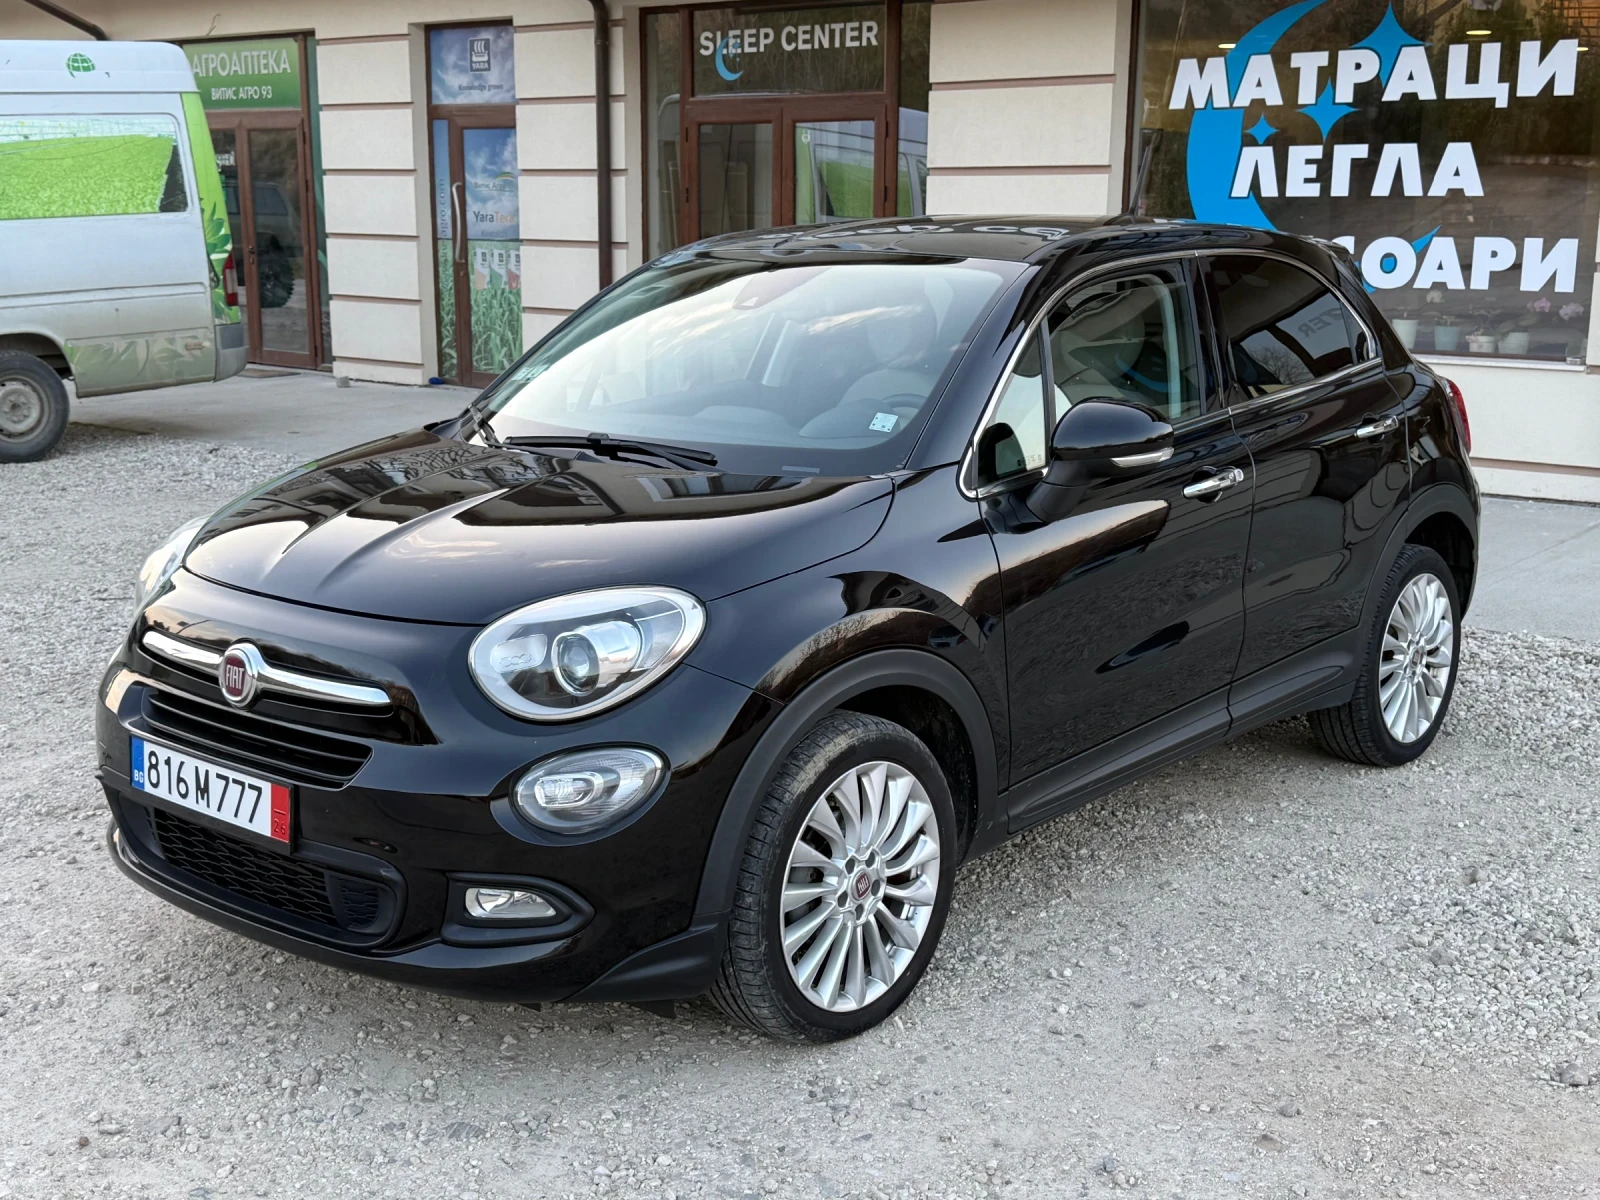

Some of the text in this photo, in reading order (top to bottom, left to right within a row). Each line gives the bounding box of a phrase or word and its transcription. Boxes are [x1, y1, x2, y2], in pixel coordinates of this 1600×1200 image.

[699, 21, 879, 57] SLEEP CENTER
[192, 48, 291, 77] АГРОАПТЕКА
[1168, 38, 1580, 111] МАТРАЦИ
[211, 85, 273, 101] ВИТИС АГРО 93
[1230, 141, 1485, 198] ЛЕГЛА
[225, 664, 246, 690] FIAT
[134, 769, 144, 784] BG
[147, 749, 263, 824] 816M777
[273, 818, 286, 836] 26
